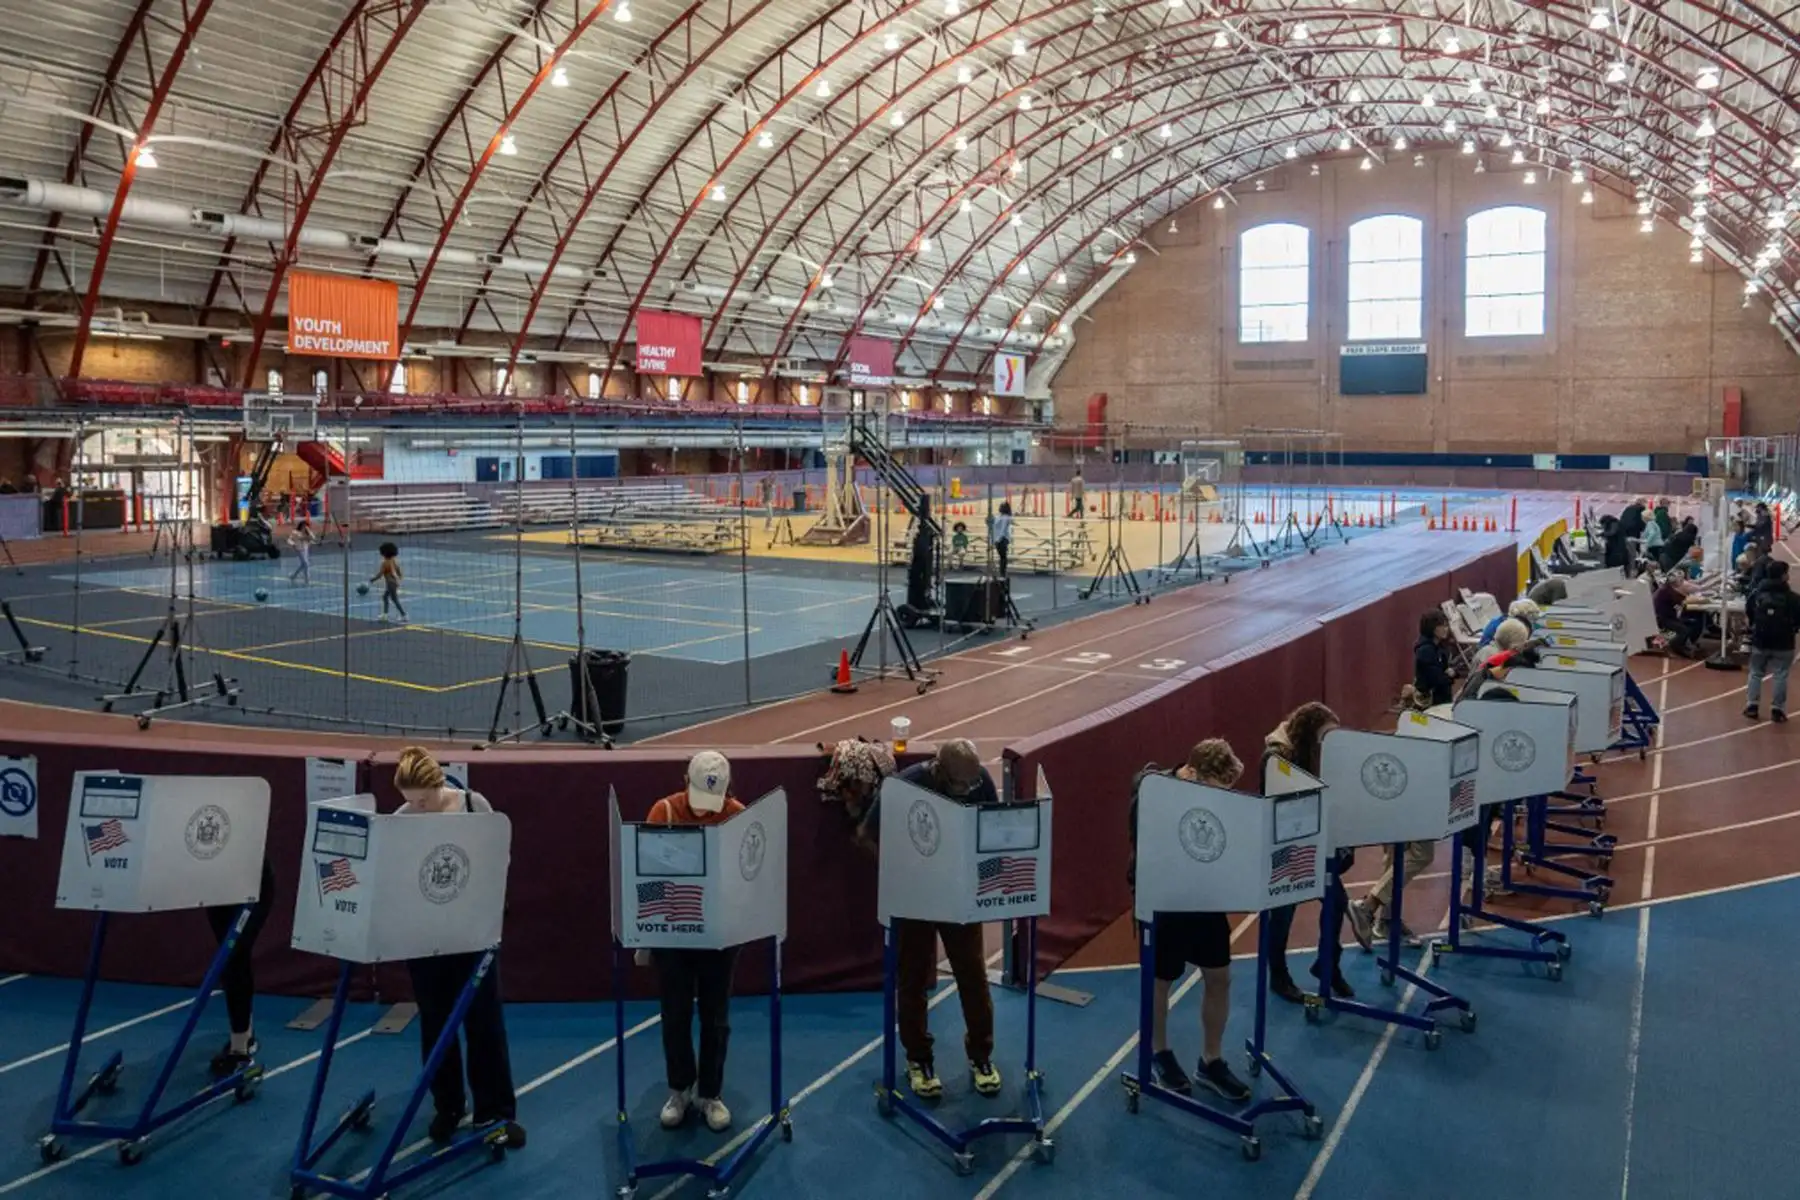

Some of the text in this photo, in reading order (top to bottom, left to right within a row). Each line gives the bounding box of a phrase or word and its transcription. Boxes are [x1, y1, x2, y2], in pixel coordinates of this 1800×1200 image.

[295, 317, 342, 334] YOUTH
[295, 335, 390, 354] DEVELOPMENT
[639, 344, 676, 358] HEALTHY
[1139, 658, 1187, 670] 3
[104, 858, 128, 869] VOTE
[1268, 885, 1291, 896] VOTE
[335, 899, 357, 914] VOTE
[976, 894, 1037, 908] VOTE HERE
[636, 922, 705, 933] VOTE HERE
